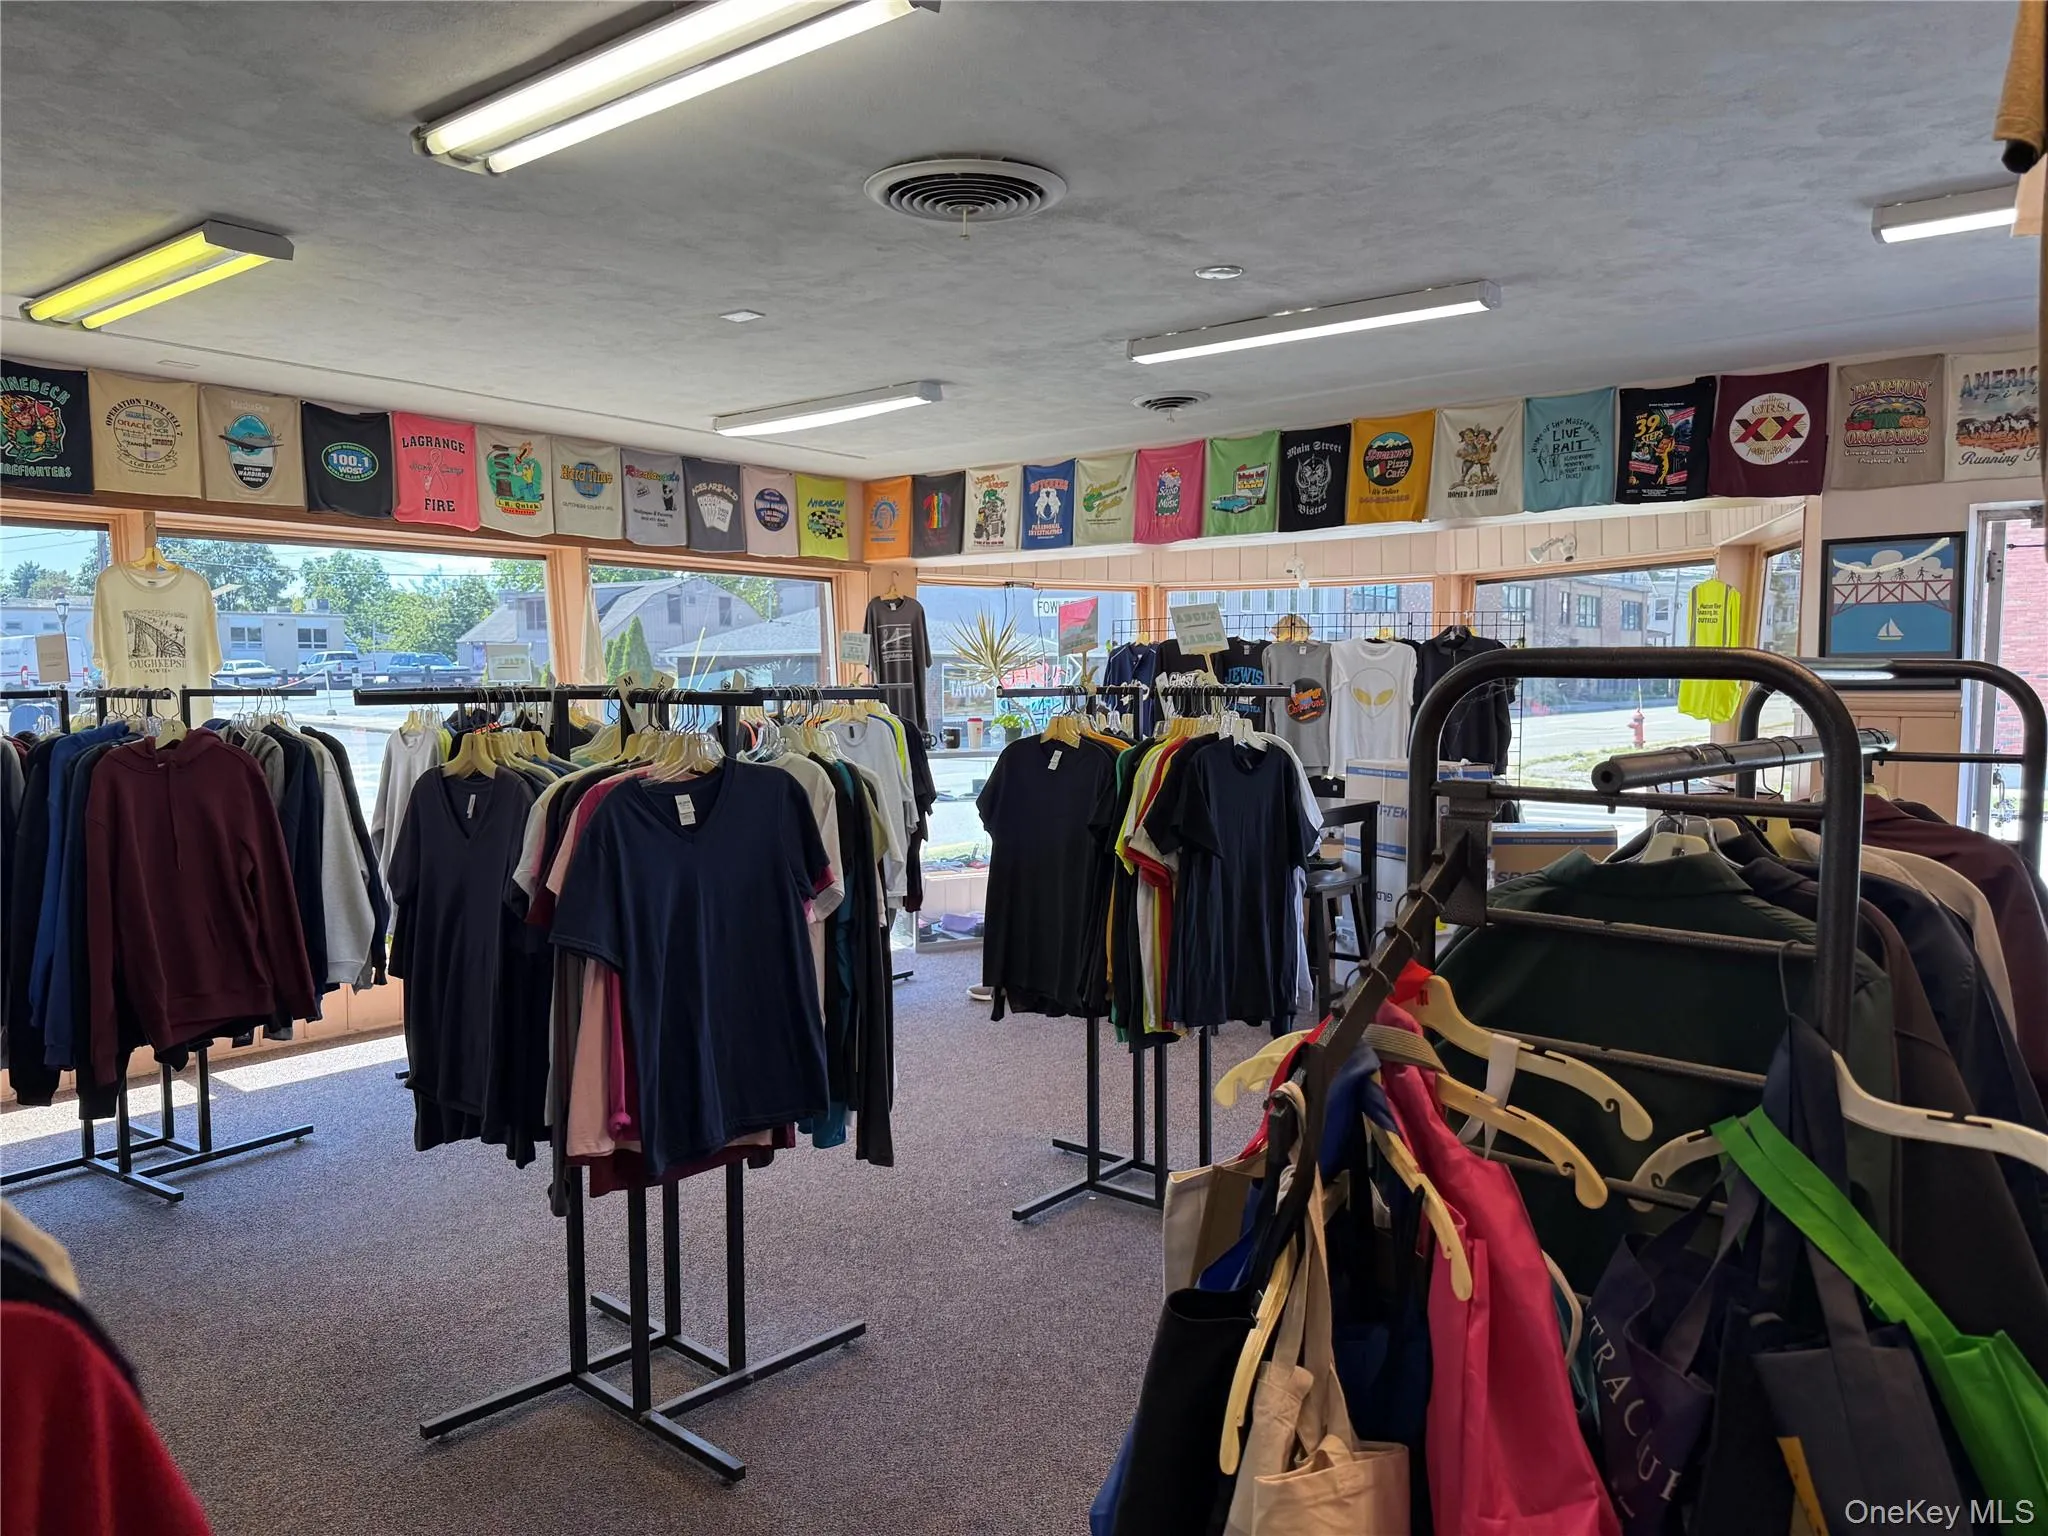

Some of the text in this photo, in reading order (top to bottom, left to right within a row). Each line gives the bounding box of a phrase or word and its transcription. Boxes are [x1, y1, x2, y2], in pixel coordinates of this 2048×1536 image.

[0, 376, 70, 405] INEBECK
[1850, 379, 1931, 402] BARTON
[106, 398, 141, 426] OPERATION
[144, 399, 167, 412] TEST
[166, 411, 181, 429] CELL
[117, 419, 152, 430] ORACLE
[1635, 414, 1660, 438] 39
[1553, 426, 1582, 442] LIVE
[1641, 429, 1664, 443] STEPS
[1845, 428, 1930, 446] ORCHARDS
[402, 435, 466, 454] LAGRANGE
[1286, 440, 1342, 459] Main Street
[1553, 438, 1590, 454] BAIT
[330, 452, 370, 467] 100.1
[1387, 460, 1409, 469] Pizza
[1958, 451, 2019, 467] Running
[237, 470, 270, 478] WARBIRDS
[560, 463, 587, 482] Hard
[588, 468, 613, 485] Time
[1158, 486, 1179, 496] SOUND
[424, 498, 456, 512] FIRE
[1158, 498, 1179, 508] MUSIC
[1297, 502, 1328, 516] Bistro
[623, 675, 634, 687] M
[1225, 667, 1264, 684] JEWIS
[949, 680, 987, 697] TATTOO
